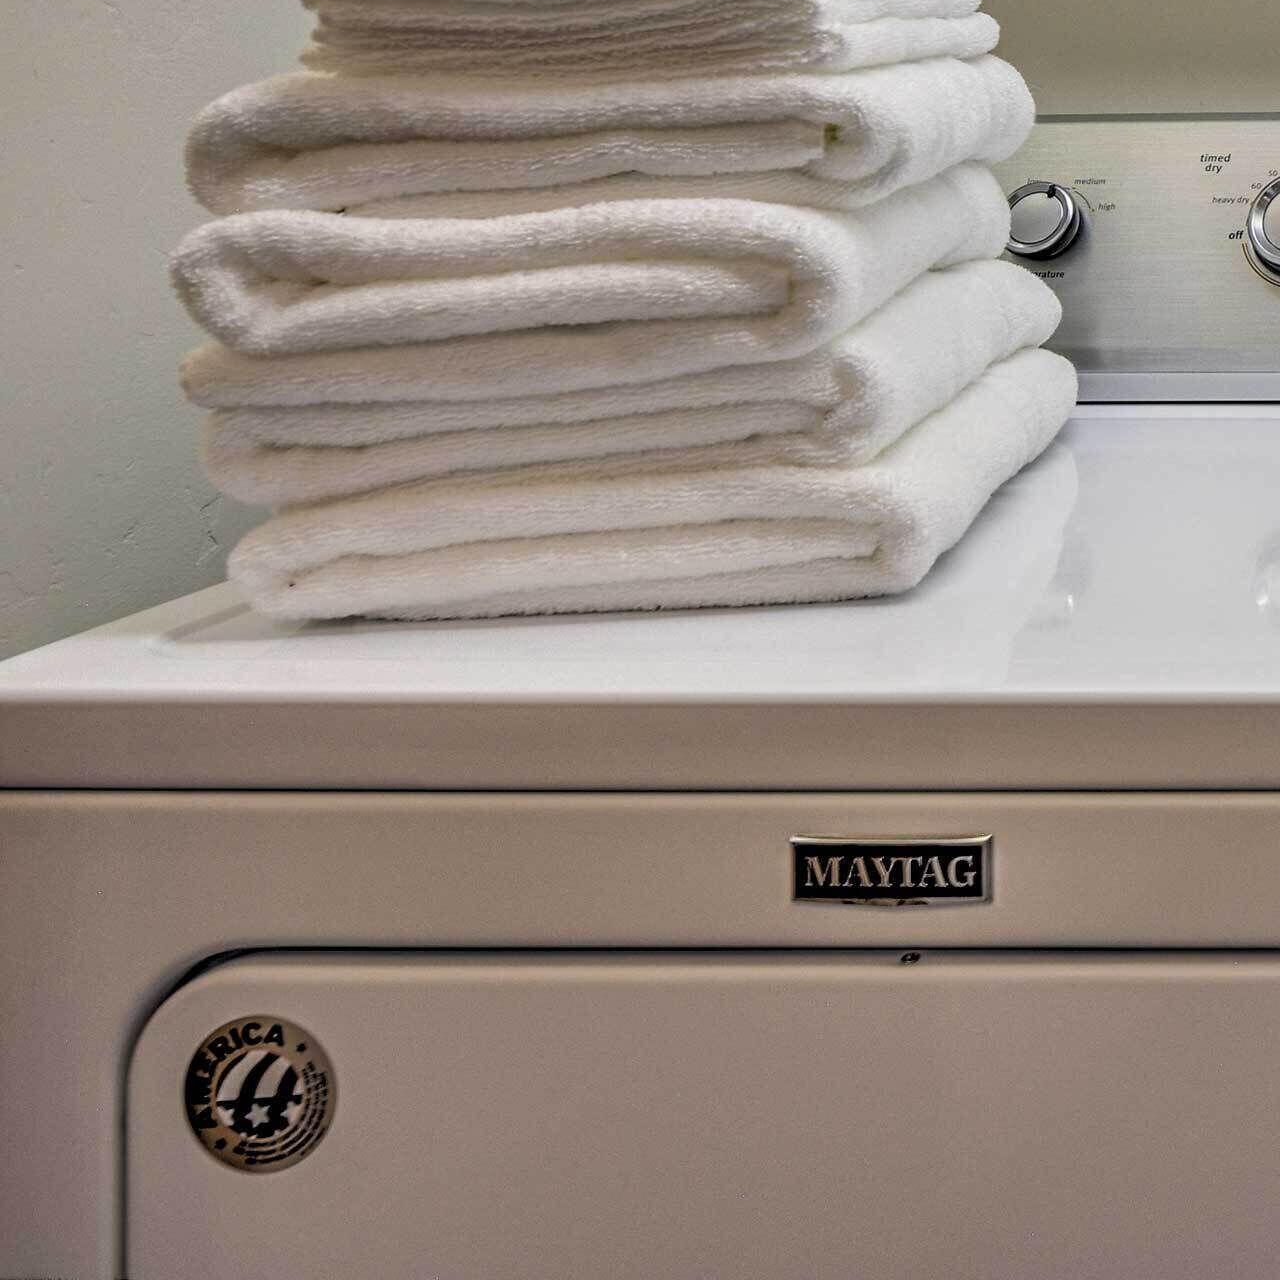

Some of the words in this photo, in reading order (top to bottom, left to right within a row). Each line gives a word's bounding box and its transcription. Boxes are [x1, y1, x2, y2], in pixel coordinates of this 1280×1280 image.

[1200, 153, 1232, 163] timed
[1205, 163, 1223, 174] dry
[1212, 197, 1235, 205] heavy
[1236, 196, 1250, 205] dry
[1098, 203, 1116, 211] high
[1228, 230, 1244, 240] off
[804, 855, 977, 888] MAYTAG
